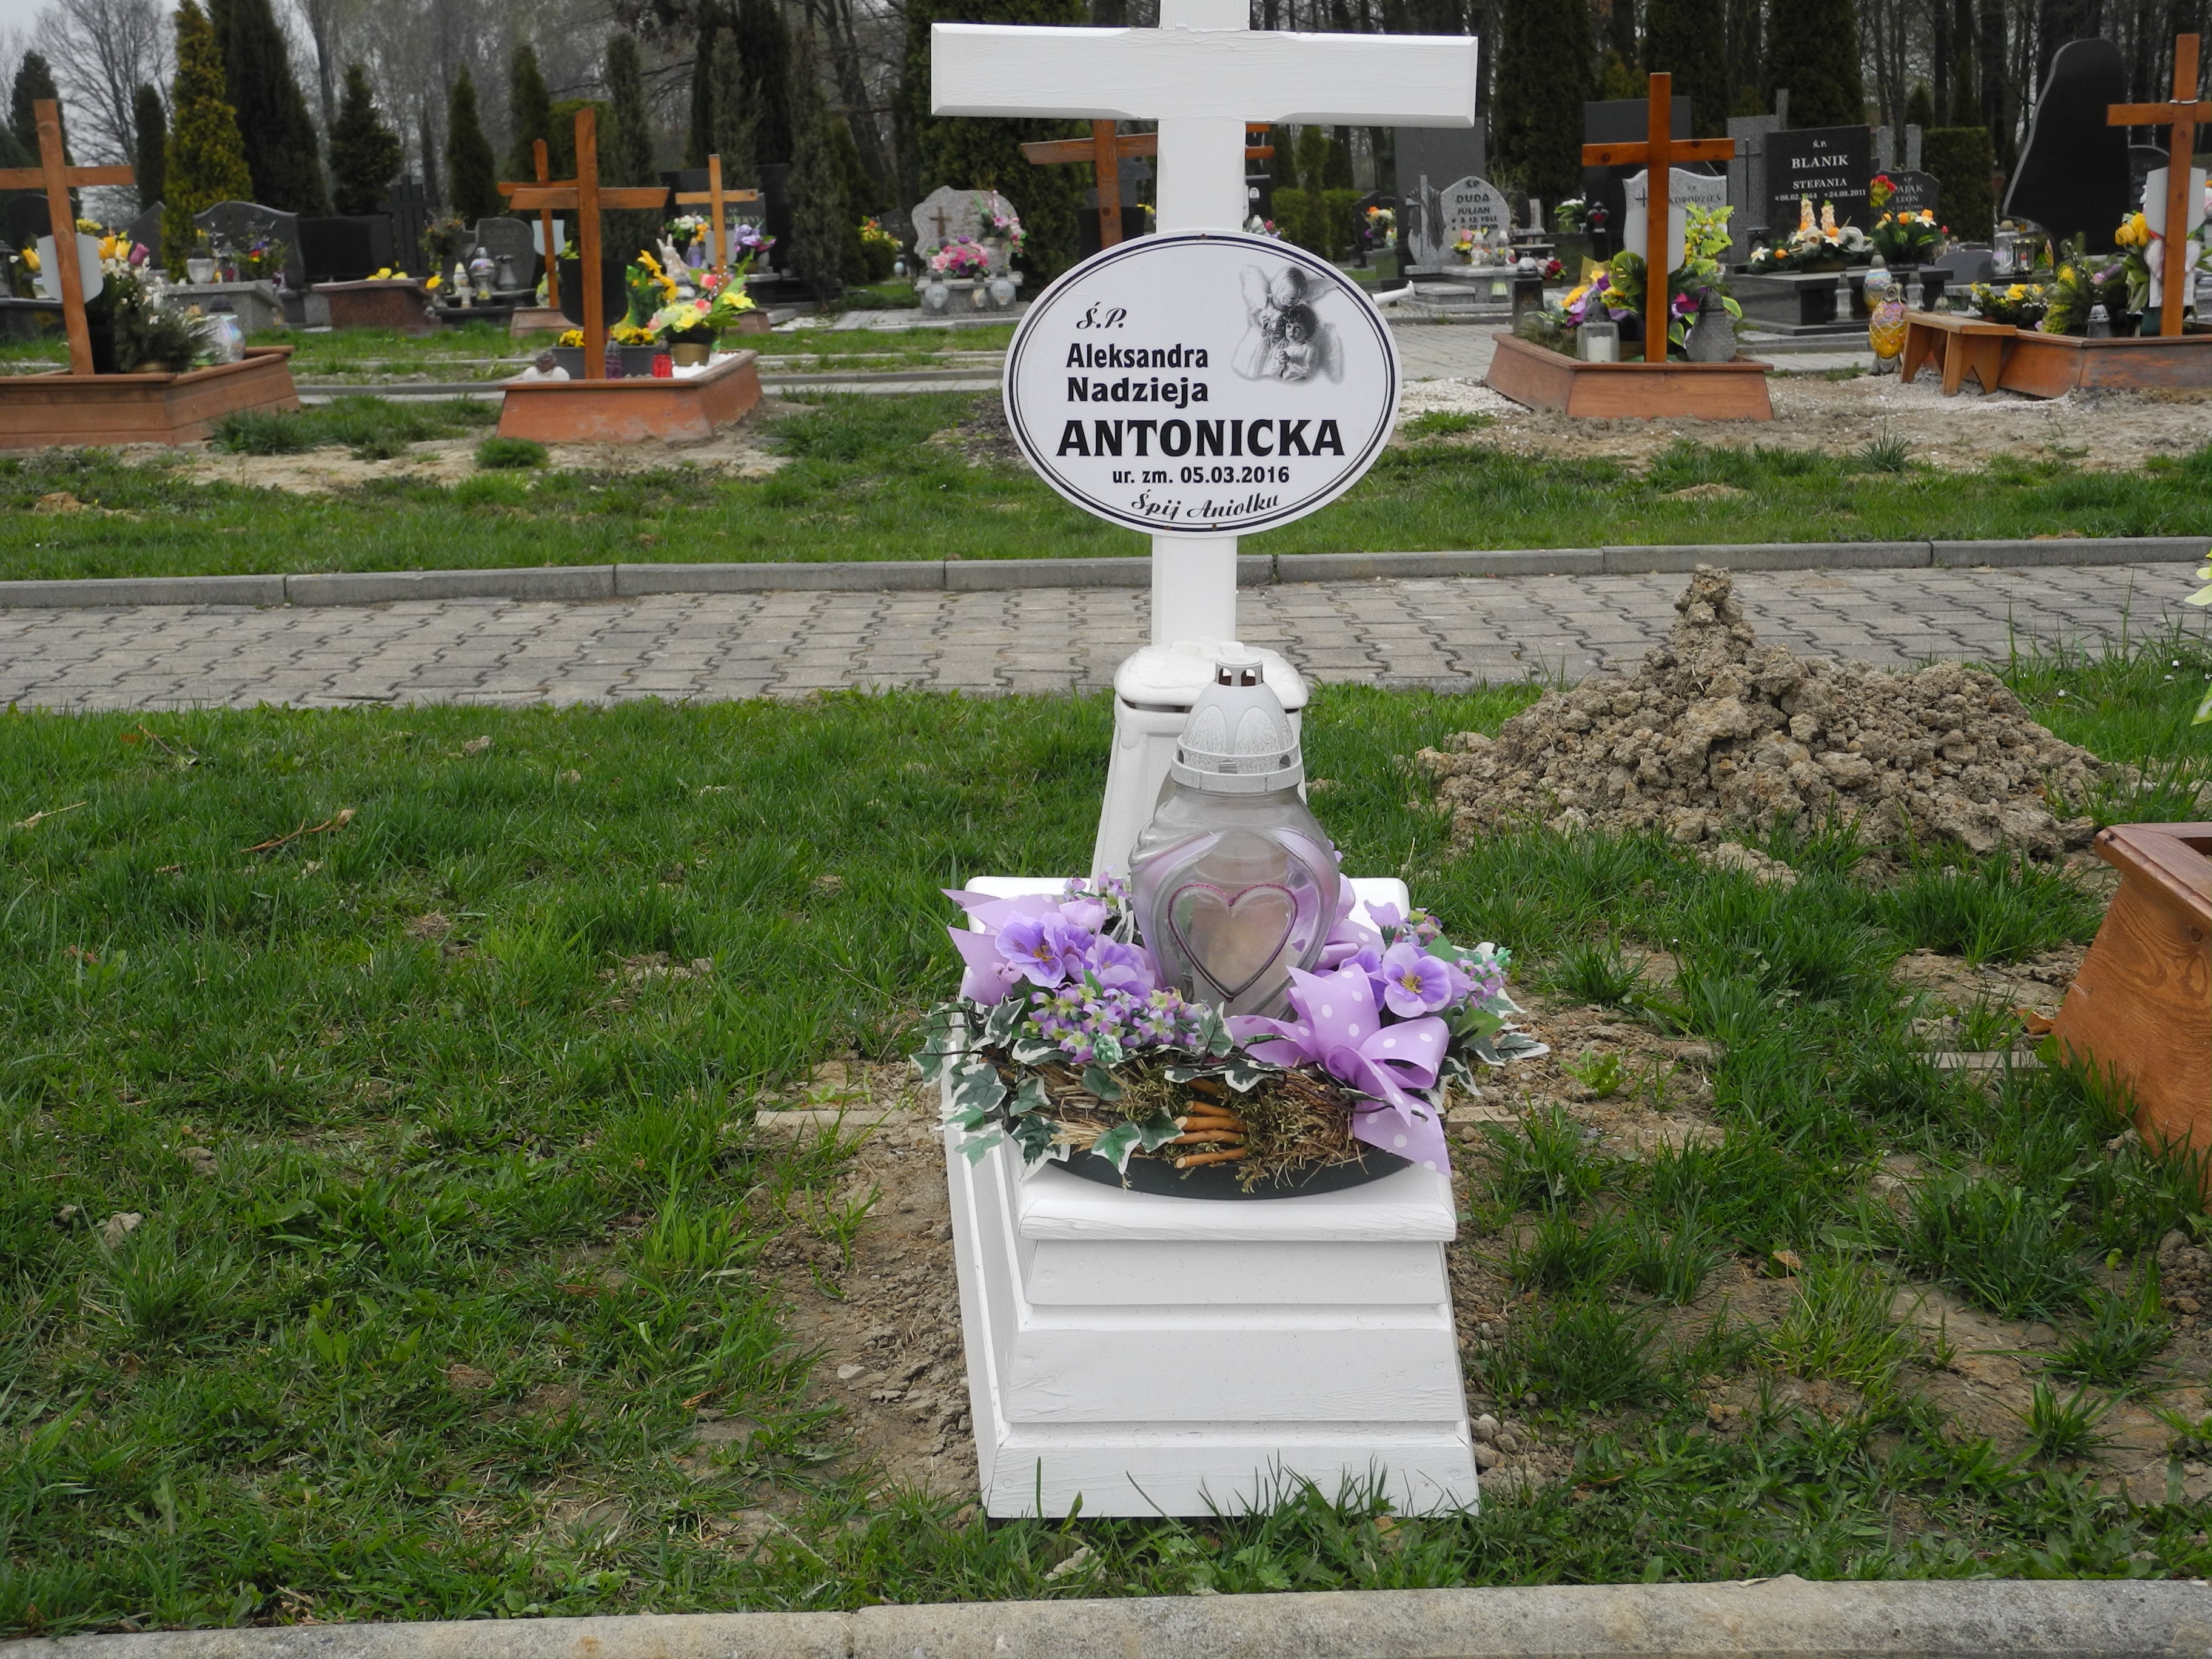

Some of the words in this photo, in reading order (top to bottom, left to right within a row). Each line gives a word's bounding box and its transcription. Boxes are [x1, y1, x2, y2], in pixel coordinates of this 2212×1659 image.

[1791, 155, 1849, 169] BLANIK
[1792, 178, 1848, 189] STEFANIA
[1456, 194, 1489, 203] DUDA
[1076, 301, 1127, 329] Ś.P.
[1065, 343, 1208, 368] Aleksandra
[1067, 377, 1209, 409] Nadzieja
[1056, 419, 1345, 457] ANTONICKA
[1113, 470, 1134, 483] ur.
[1142, 470, 1173, 483] zm.
[1181, 466, 1290, 483] 05.03.2016
[1131, 489, 1181, 520] Śpij
